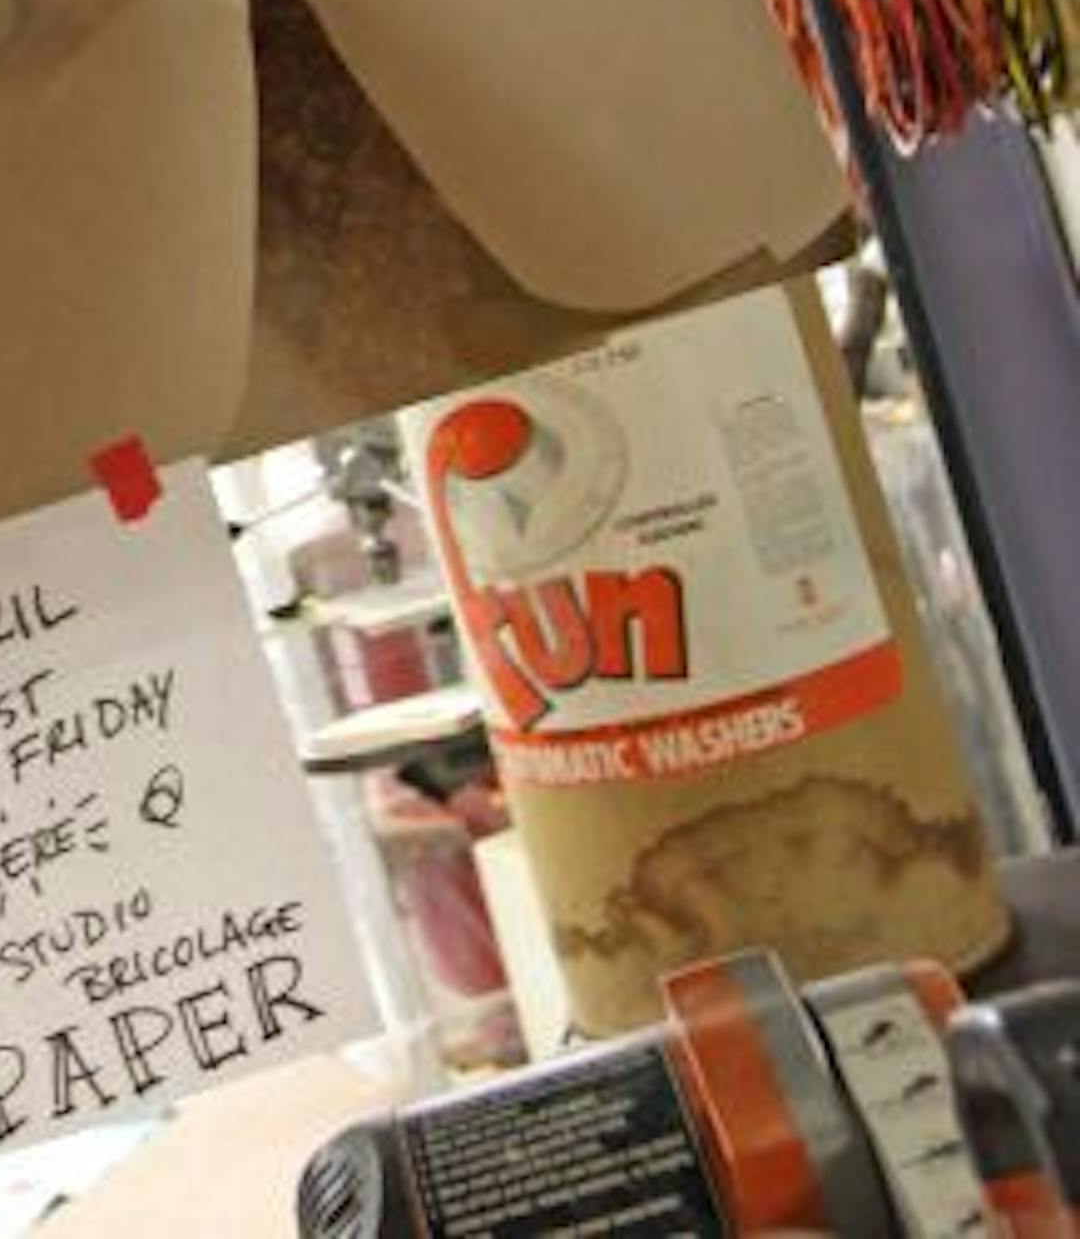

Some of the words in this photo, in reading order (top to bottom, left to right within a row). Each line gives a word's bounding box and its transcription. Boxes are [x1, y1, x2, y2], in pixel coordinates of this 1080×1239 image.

[9, 668, 175, 784] FRIDAY
[638, 698, 806, 774] WASHERS
[64, 901, 303, 1003] BRICOLAGE
